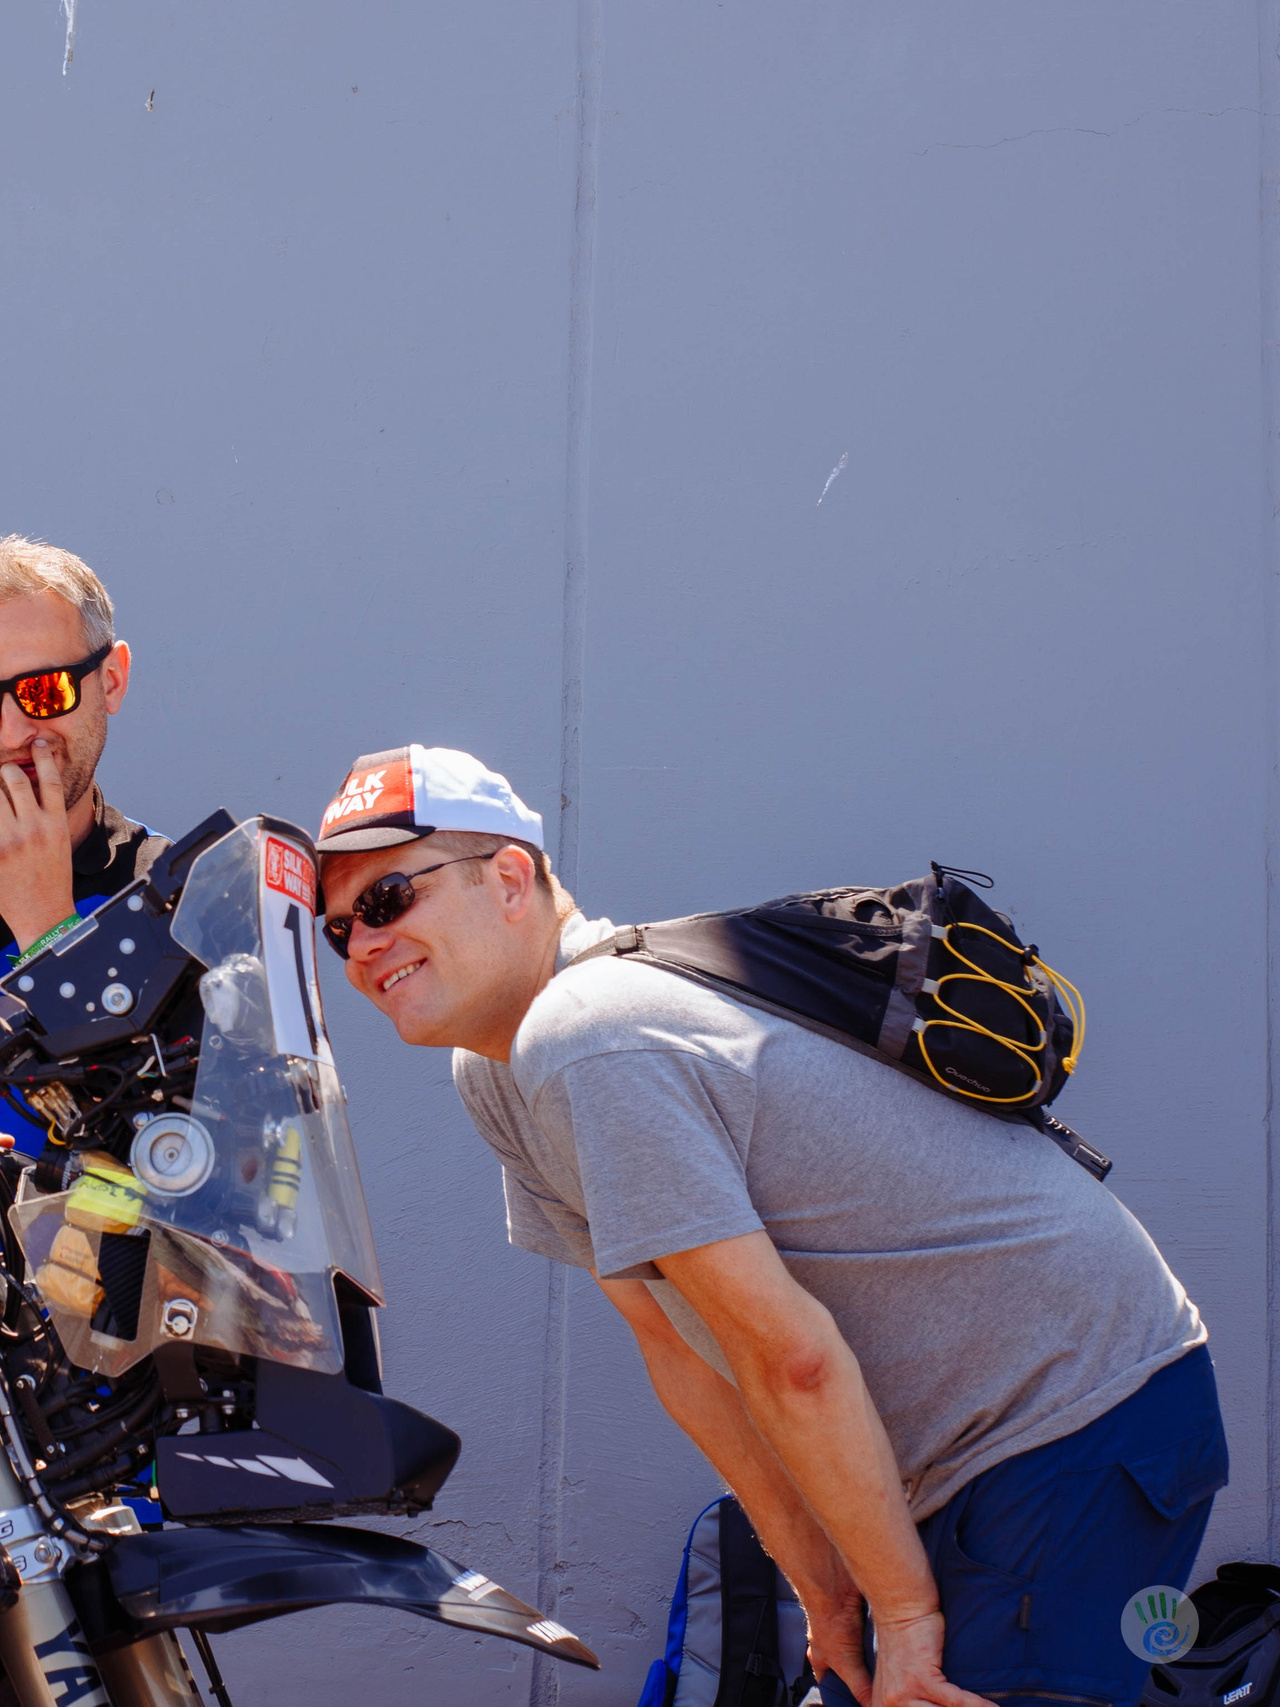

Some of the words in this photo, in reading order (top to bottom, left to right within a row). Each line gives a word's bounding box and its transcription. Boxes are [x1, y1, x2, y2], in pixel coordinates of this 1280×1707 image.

[326, 788, 384, 825] WAY
[283, 849, 302, 877] SILK
[284, 869, 302, 898] WAY
[40, 928, 61, 948] RALLY
[283, 902, 319, 1055] 1
[1223, 1682, 1253, 1706] LEATT
